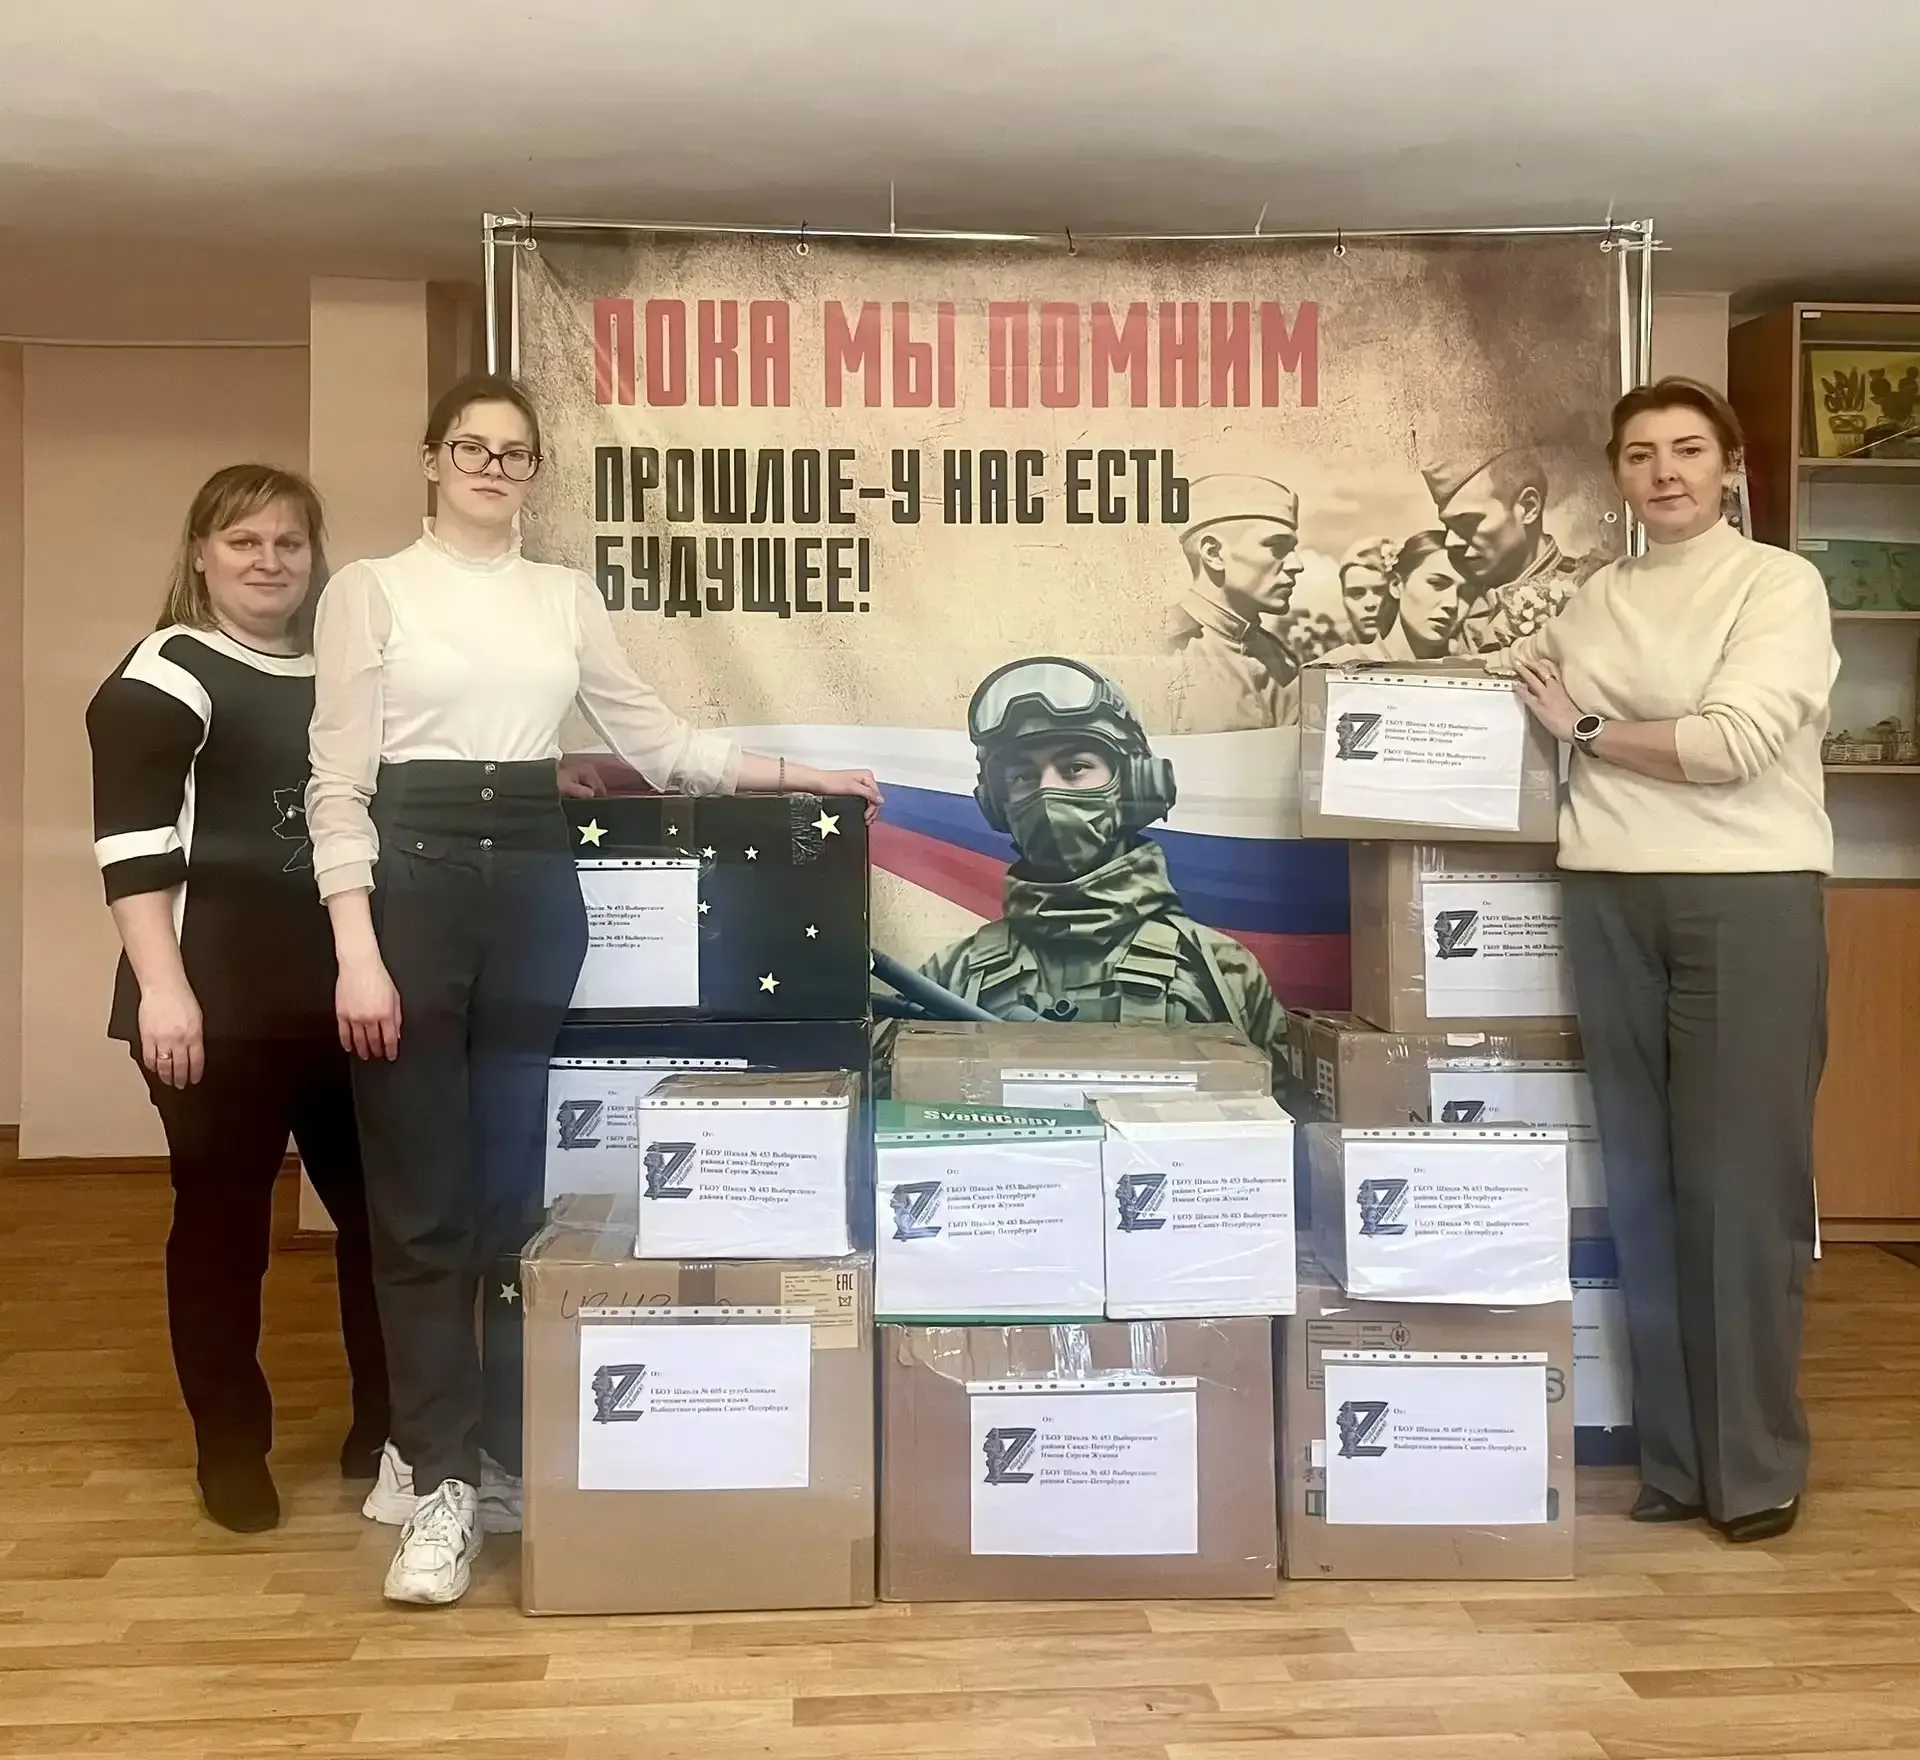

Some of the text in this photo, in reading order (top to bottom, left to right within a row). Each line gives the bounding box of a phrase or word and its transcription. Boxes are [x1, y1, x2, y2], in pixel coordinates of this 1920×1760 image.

[594, 299, 1319, 408] ПОКА МЫ ПОМНИМ
[944, 449, 1043, 523] НАС
[1066, 449, 1189, 523] ЕСТЬ
[598, 536, 870, 618] БУДУЩЕЕ!
[836, 1273, 854, 1291] EAC
